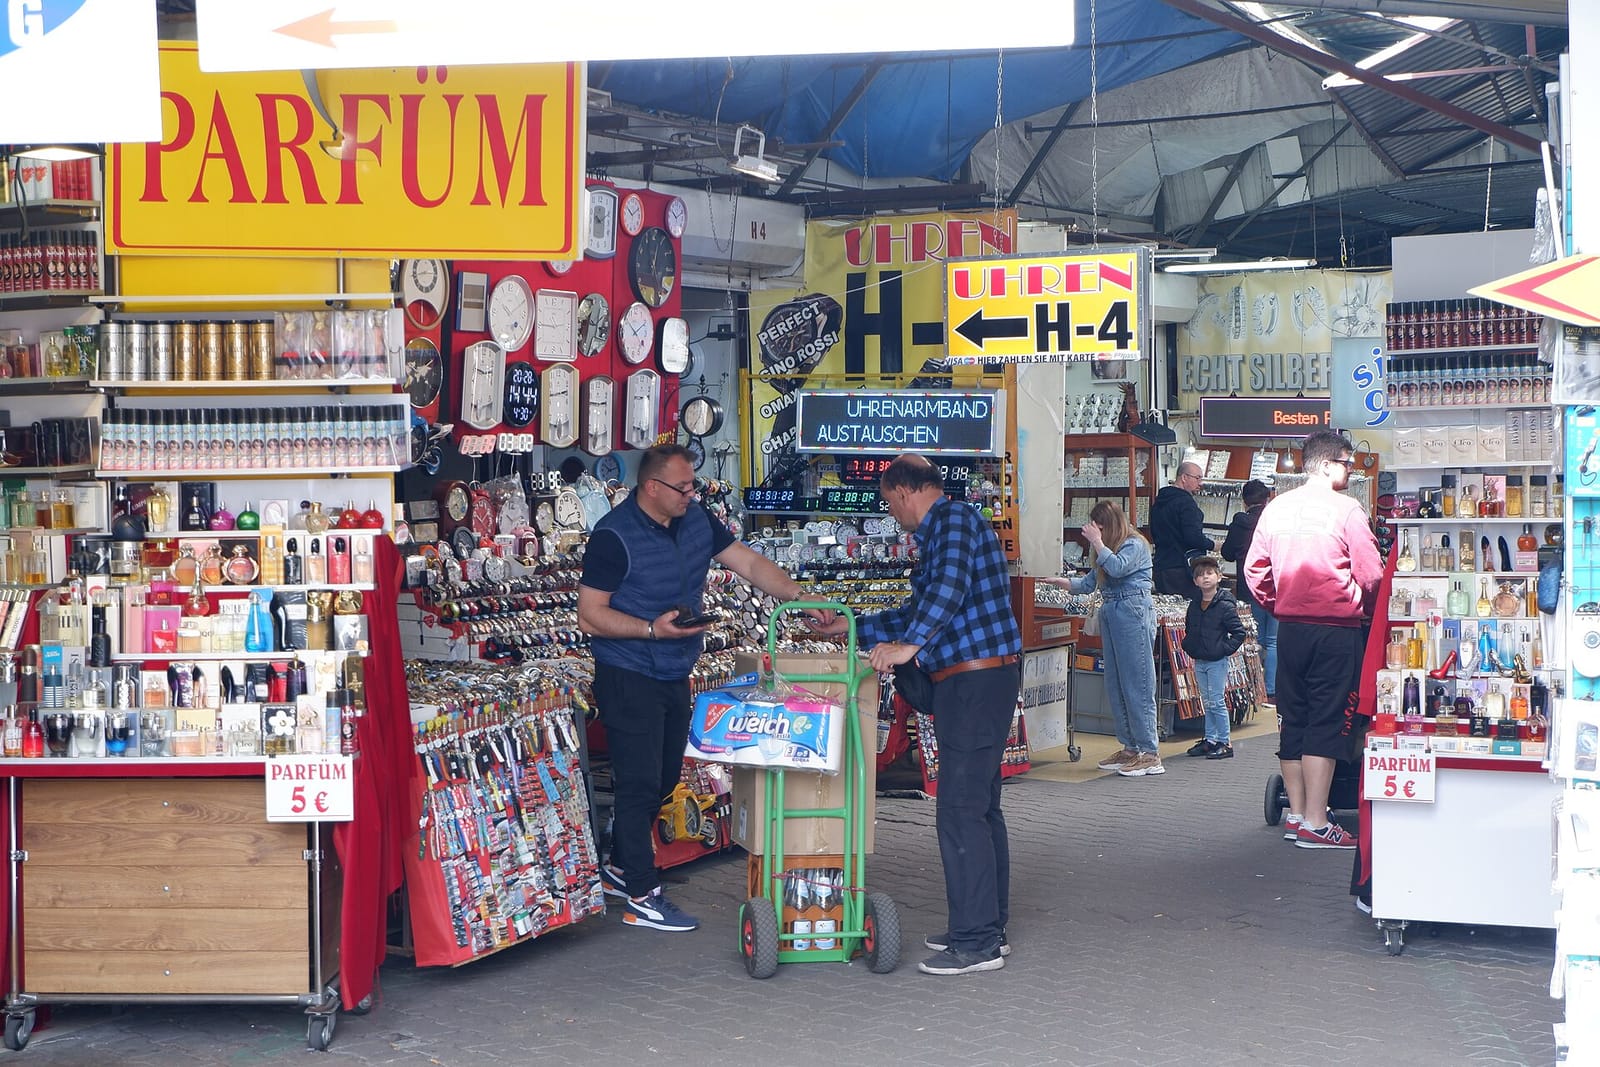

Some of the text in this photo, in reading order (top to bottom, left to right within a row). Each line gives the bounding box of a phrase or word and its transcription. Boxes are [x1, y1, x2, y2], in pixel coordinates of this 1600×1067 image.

[138, 64, 549, 209] PARFÜM
[844, 217, 1013, 267] UHREN
[953, 260, 1134, 299] UHREN
[758, 301, 821, 346] PERFECT
[1035, 301, 1134, 352] H-4
[797, 330, 839, 363] ROSSI
[945, 356, 963, 365] VISA
[977, 356, 997, 365] HIER
[998, 355, 1032, 364] ZAHLEN
[1034, 355, 1047, 363] SIE
[1049, 354, 1065, 363] MIT
[1067, 353, 1096, 362] KARTE
[1181, 353, 1245, 392] ECHT
[847, 399, 988, 418] UHRENARMBAND
[1273, 410, 1319, 426] Besten
[817, 424, 939, 443] AUSTAUSCHEN
[728, 712, 791, 735] weich
[271, 758, 347, 780] PARFÜM
[1369, 754, 1431, 772] PARFÜM
[291, 785, 329, 813] 5 €
[1384, 774, 1416, 798] 5 €
